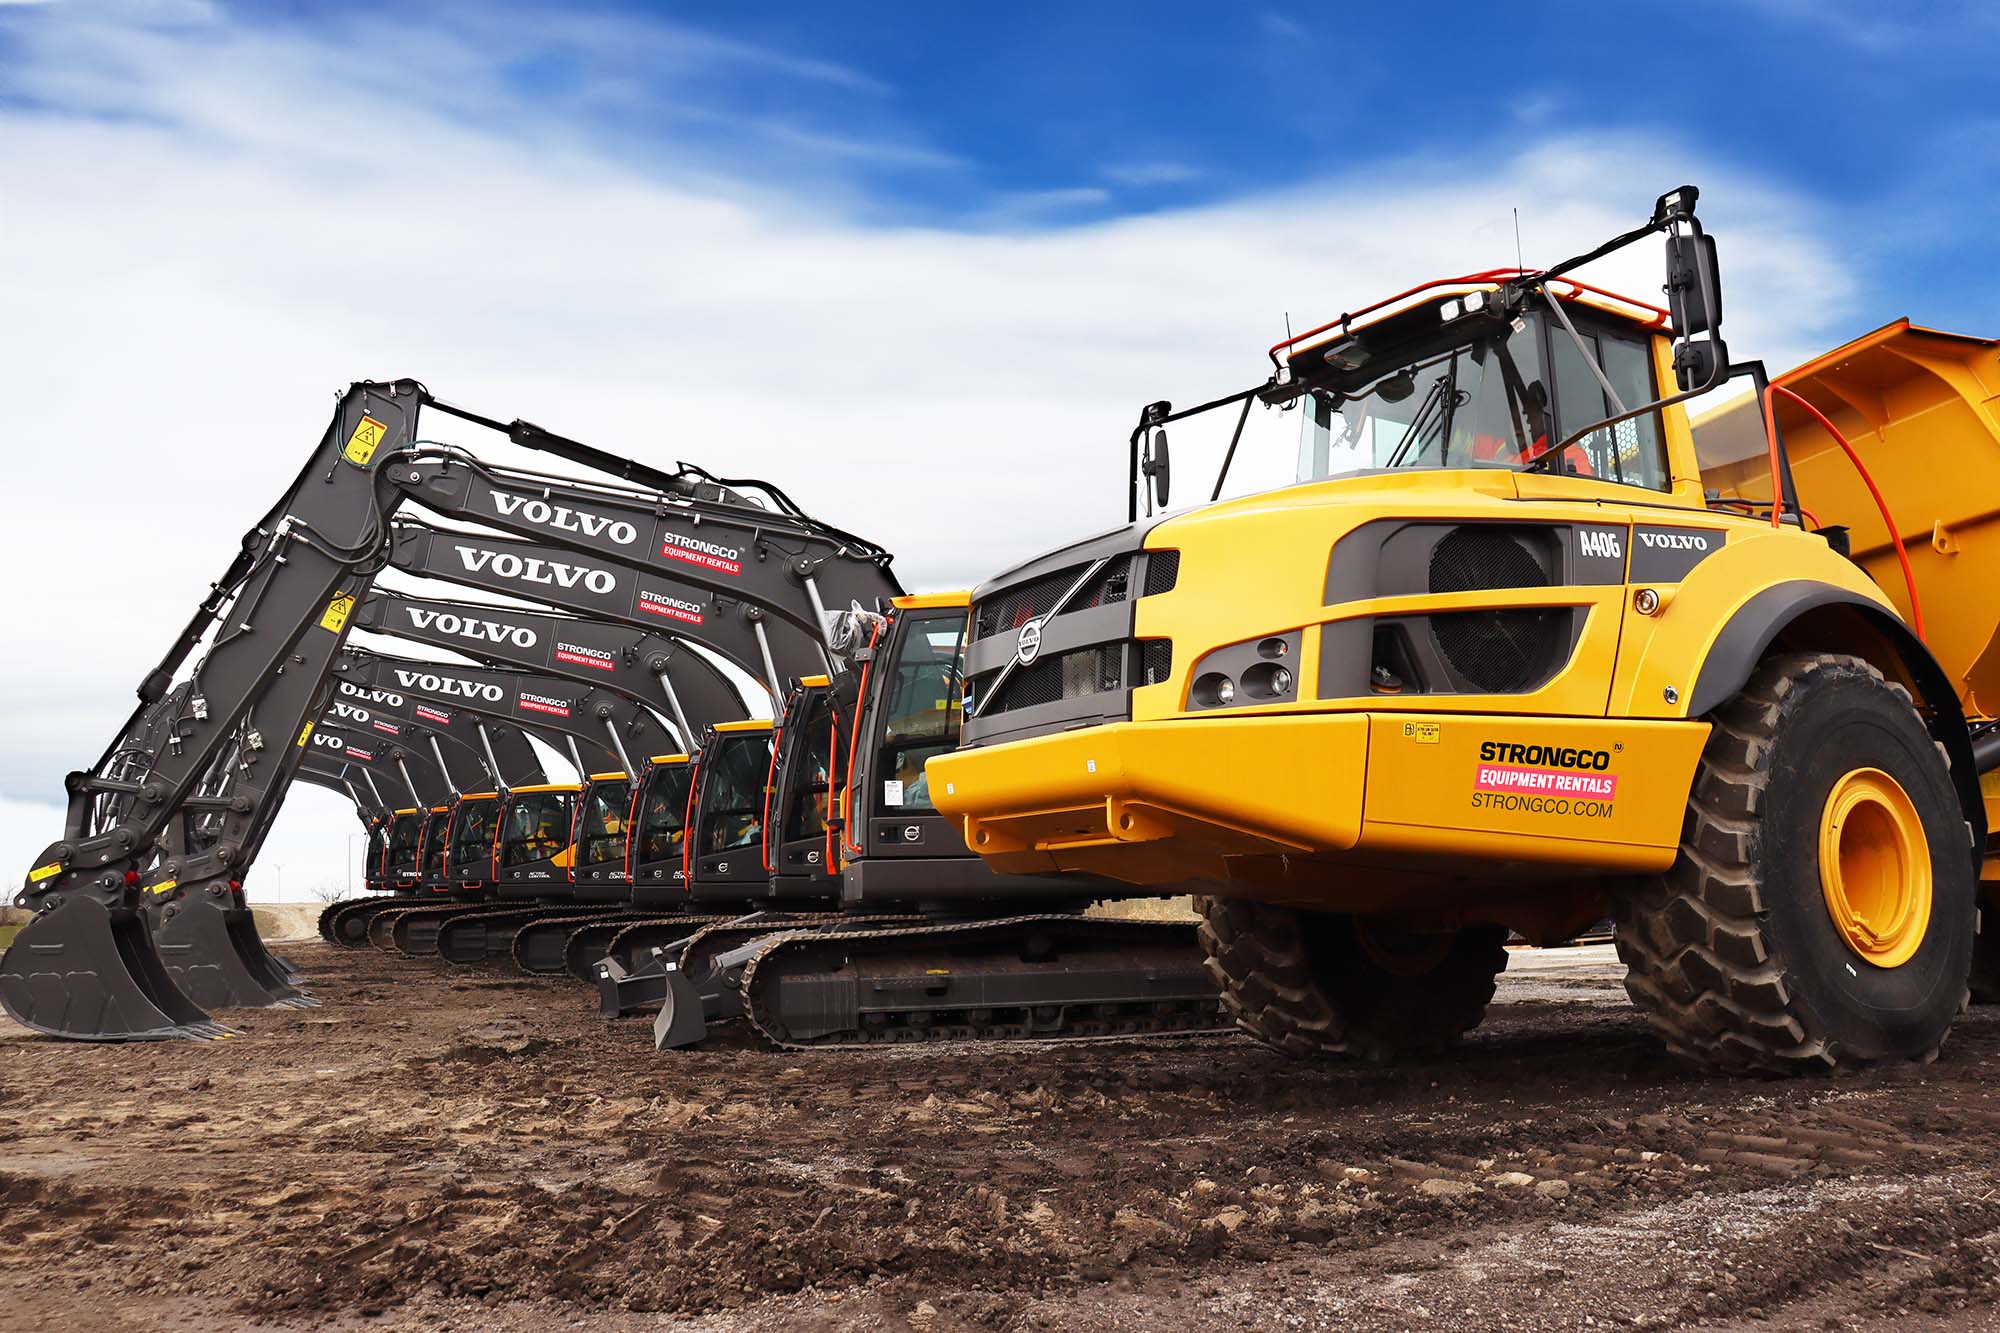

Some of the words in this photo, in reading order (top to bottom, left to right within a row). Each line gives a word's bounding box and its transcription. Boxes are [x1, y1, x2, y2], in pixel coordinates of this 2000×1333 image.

[490, 491, 637, 545] VOLVO
[664, 532, 738, 560] STRONGCO
[1580, 531, 1621, 558] A40G
[1638, 533, 1708, 551] VOLVO
[455, 545, 616, 595] VOLVO
[664, 546, 706, 565] EQUIPMENT
[706, 557, 739, 573] RENTALS
[641, 591, 700, 613] STRONGCO
[641, 601, 676, 616] EQUIPMENT
[675, 611, 702, 623] RENTALS
[406, 607, 537, 649] VOLVO
[1018, 636, 1039, 646] VOLVO
[557, 642, 611, 660] STRONGCO
[340, 681, 404, 707] OLVO
[394, 669, 504, 702] VOLVO
[417, 704, 449, 718] STRONGCO
[520, 692, 567, 708] STRONGCO
[1480, 741, 1610, 771] STRONGCO
[1480, 769, 1556, 789] EQUIPMENT
[1555, 776, 1612, 794] RENTALS
[1472, 792, 1613, 818] STRONGCO.COM
